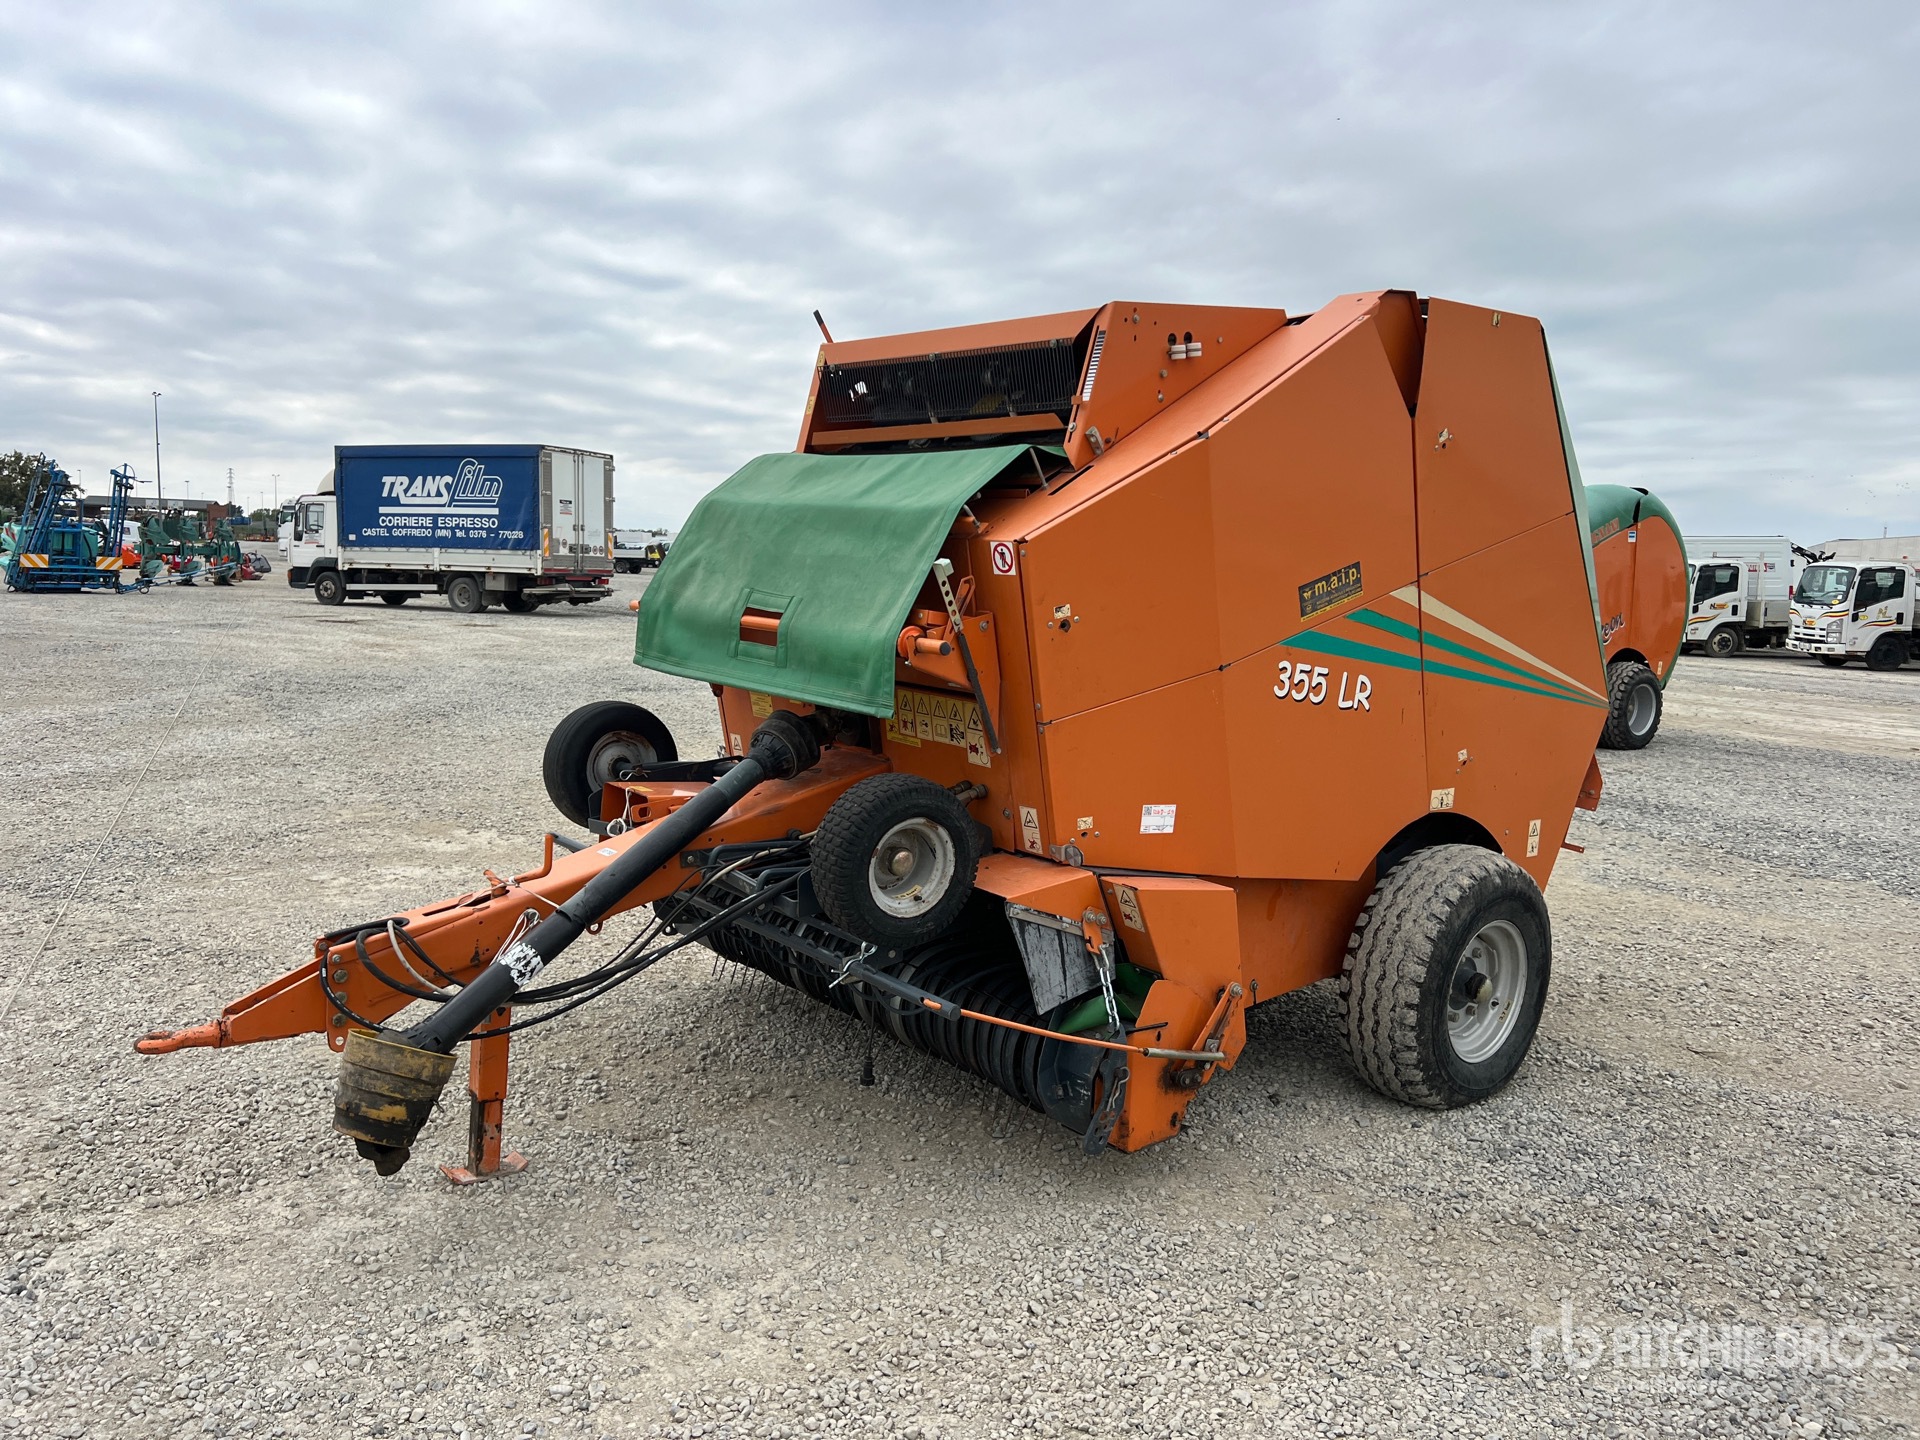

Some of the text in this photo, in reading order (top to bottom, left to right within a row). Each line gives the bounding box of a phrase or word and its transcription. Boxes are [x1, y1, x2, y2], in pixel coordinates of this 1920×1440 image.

[379, 516, 498, 528] CORRIERE ESPRESSO
[362, 528, 389, 536] CASTEL
[391, 528, 432, 537] GOFFREDO
[435, 529, 452, 538] (MN)
[455, 530, 467, 538] Tel.
[469, 530, 487, 538] 0376
[1315, 568, 1360, 596] m.a.i.p.
[1273, 660, 1372, 712] 355 LR
